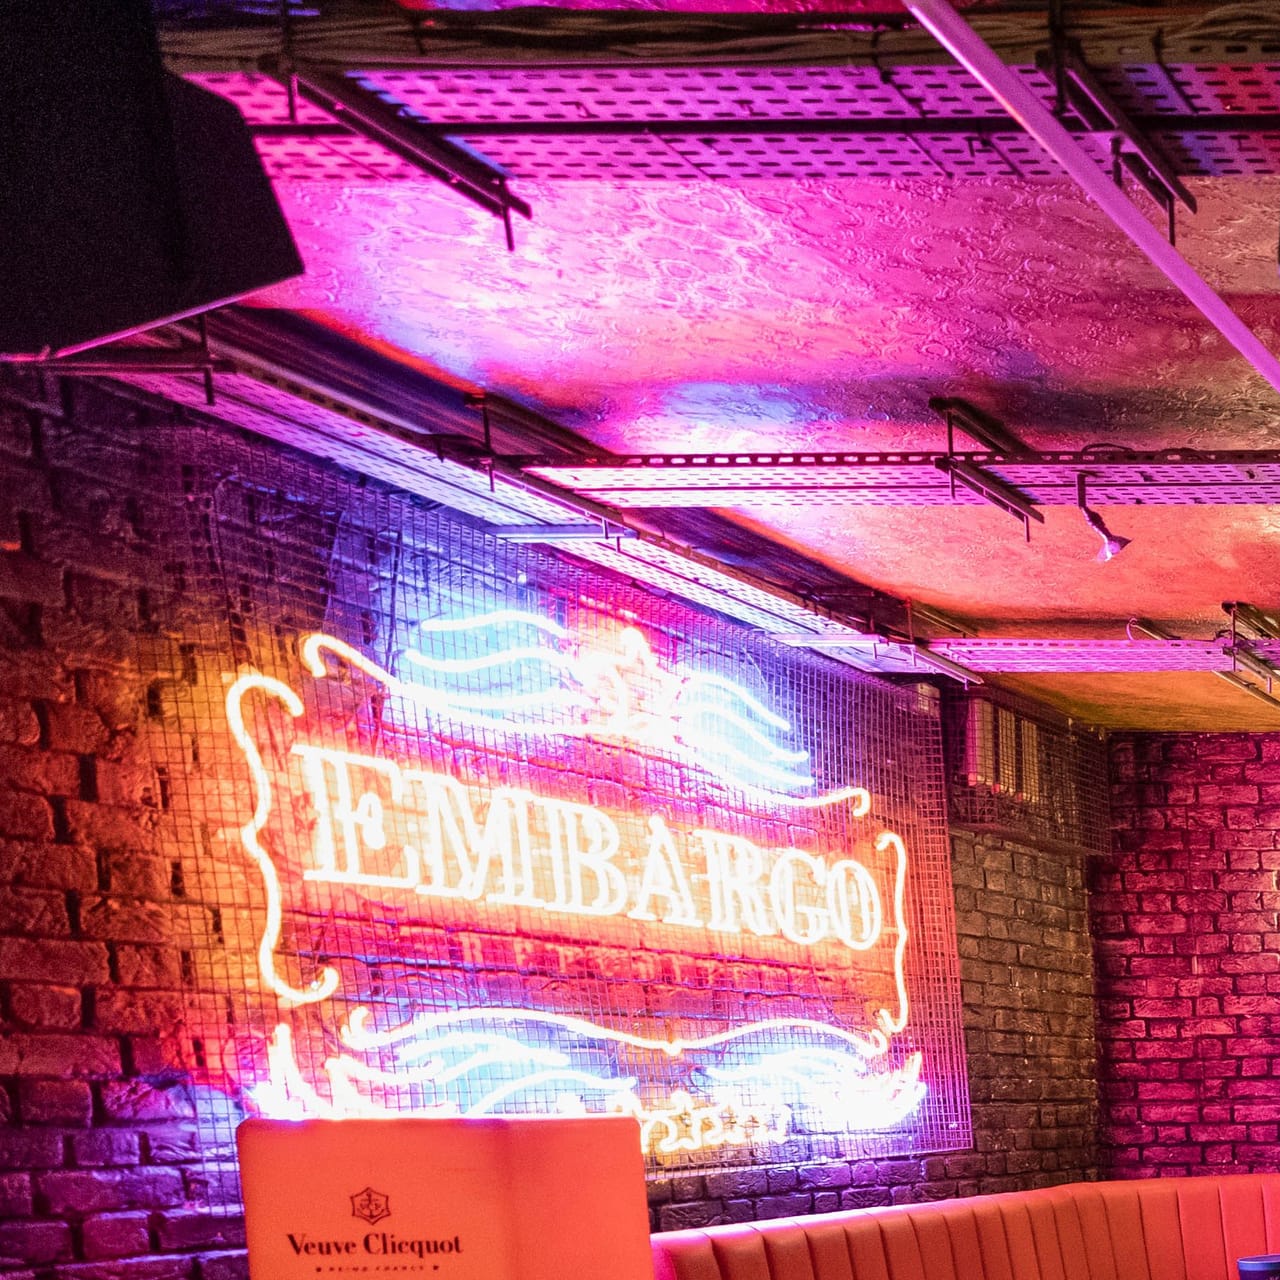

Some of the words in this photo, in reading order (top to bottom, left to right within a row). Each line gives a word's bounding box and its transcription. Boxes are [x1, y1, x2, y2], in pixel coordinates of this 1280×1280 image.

[291, 744, 885, 950] EMBARGO
[287, 1232, 357, 1257] Veuve
[363, 1232, 465, 1259] Clicquot
